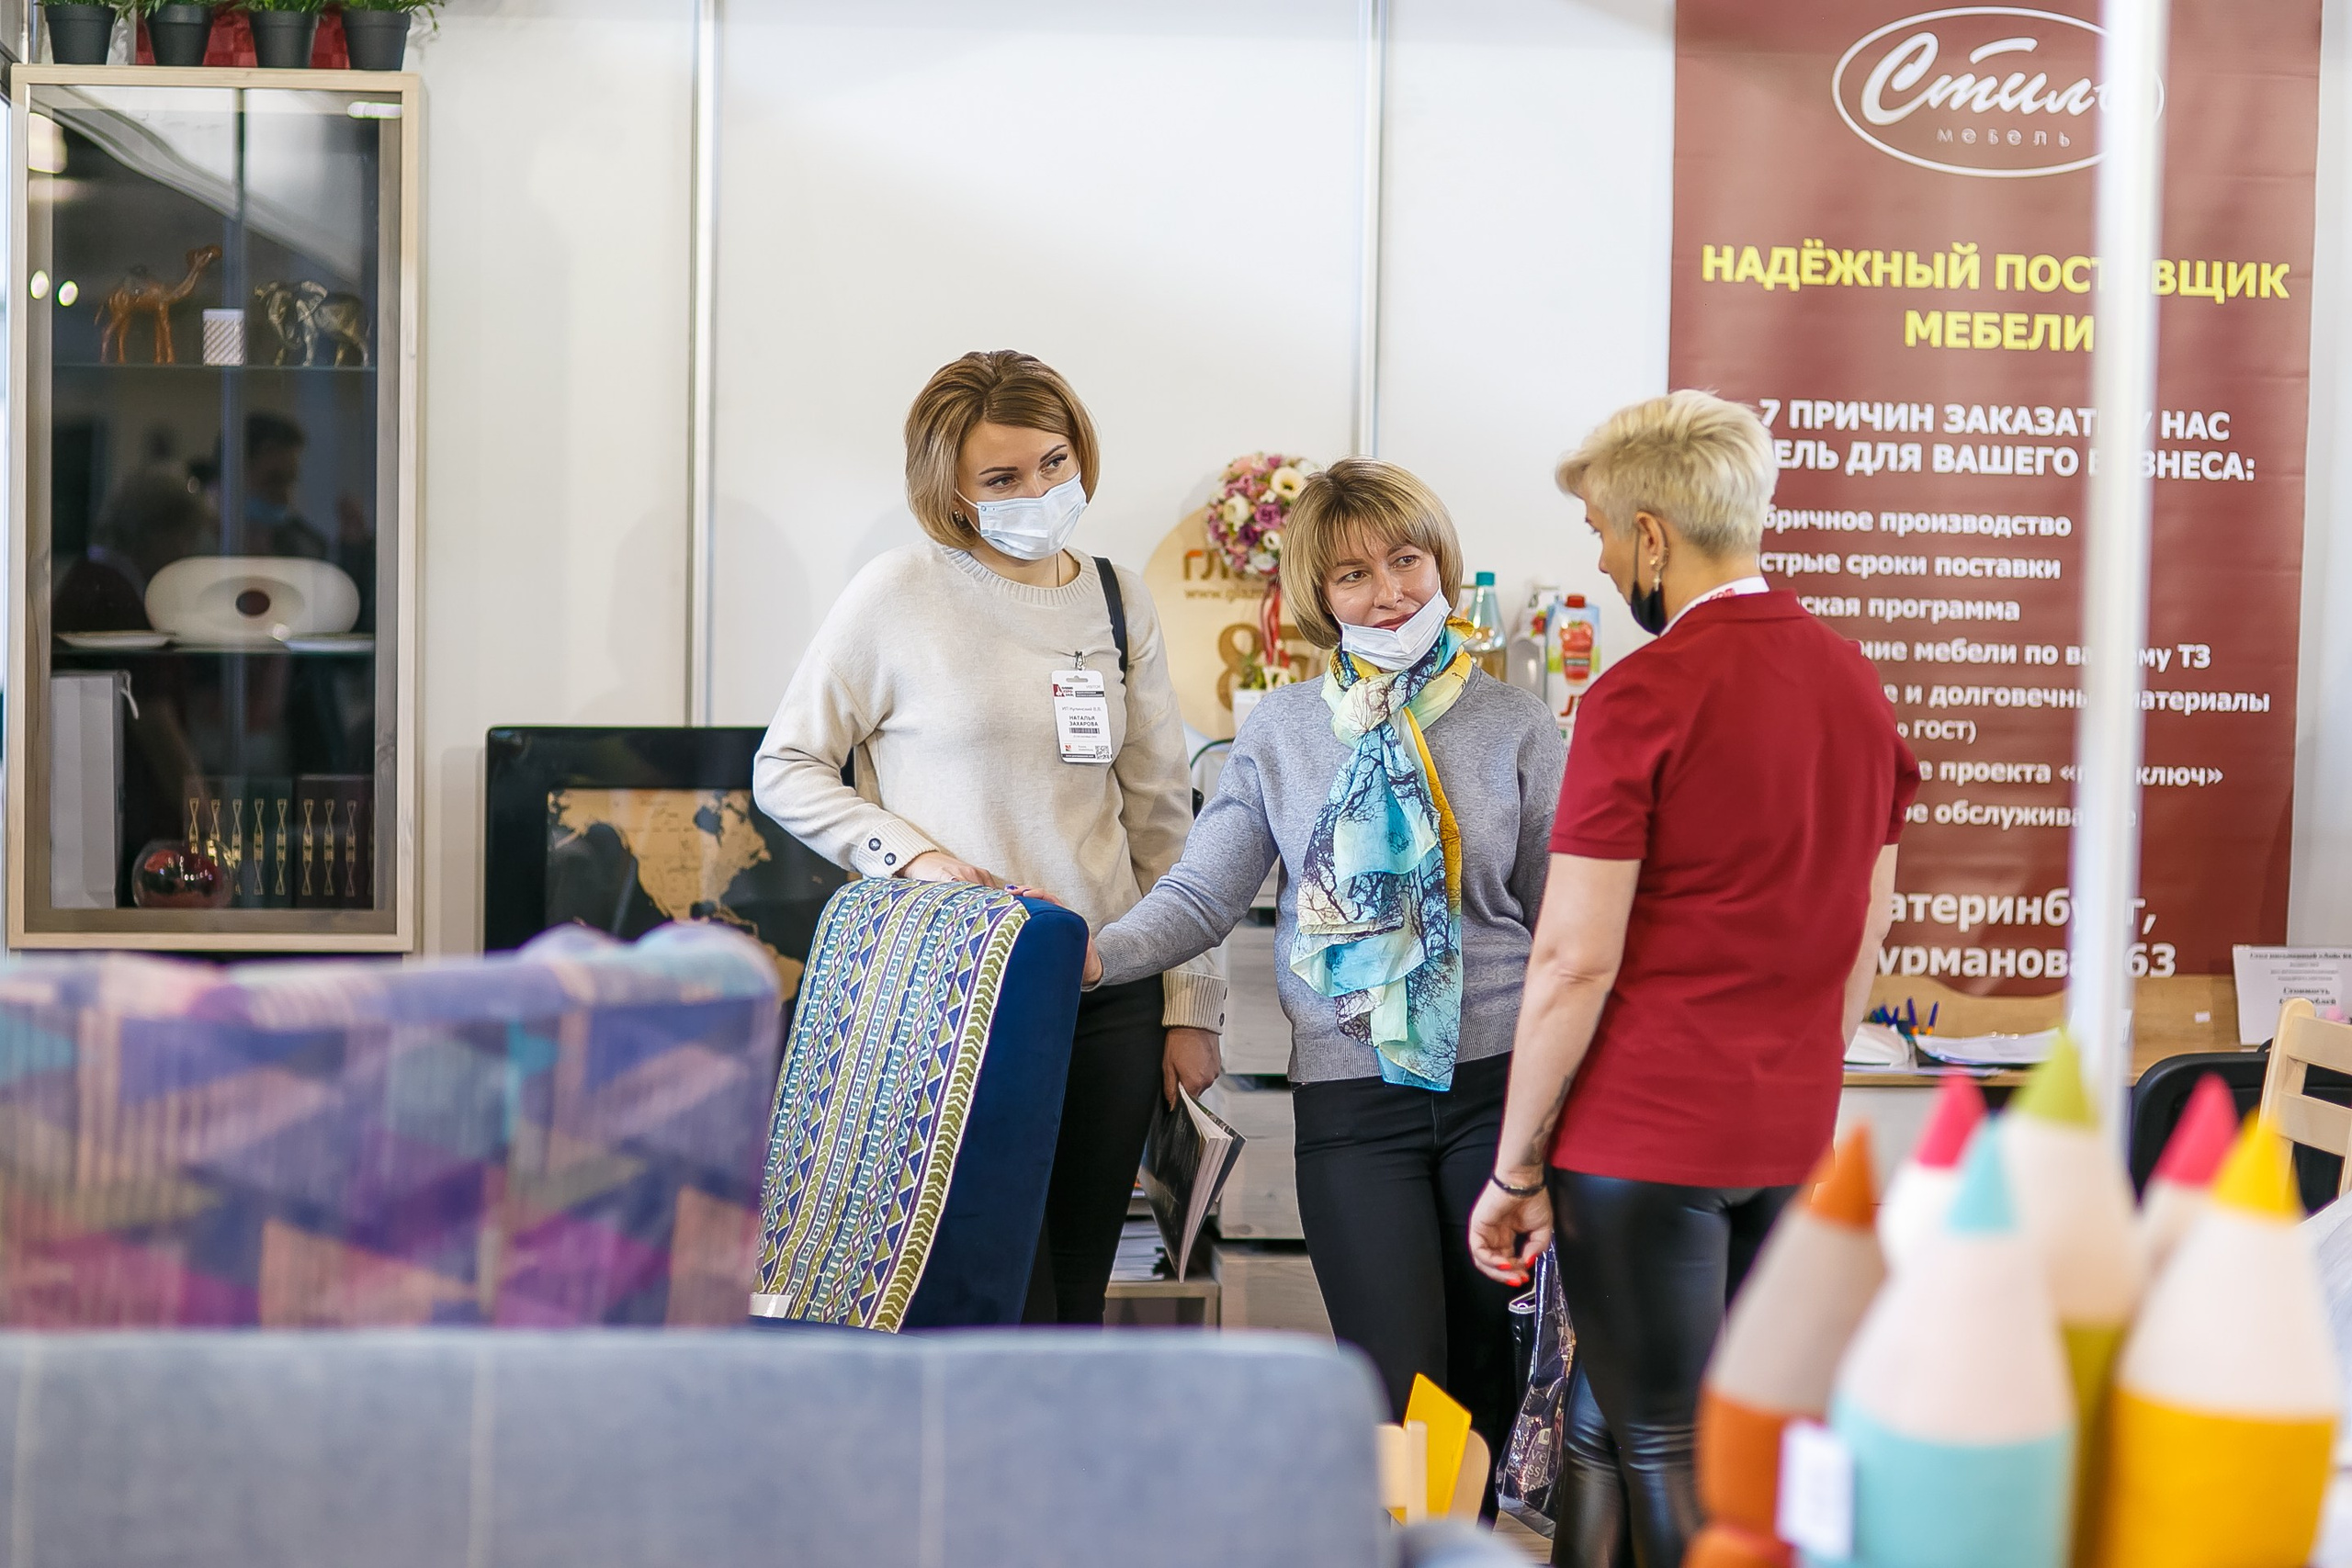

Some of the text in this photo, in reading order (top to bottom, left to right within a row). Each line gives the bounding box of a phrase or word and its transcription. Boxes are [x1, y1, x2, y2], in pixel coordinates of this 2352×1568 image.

[1702, 237, 2290, 305] НАДЁЖНЫЙ ПОСТВЩИК
[1905, 309, 2095, 353] МЕБЕЛИ
[1758, 398, 1781, 429] 7
[1789, 399, 1935, 433] ПРИЧИН
[1942, 402, 2100, 438] ЗАКАЗАТ
[2161, 410, 2231, 442] НАС
[1773, 437, 1839, 470] ЕЛЬ
[1845, 440, 1922, 477] ДЛЯ
[1932, 442, 2080, 478] ВАШЕГО
[1763, 504, 2073, 539] бричное производство
[1757, 551, 2062, 580] стрые сроки поставки
[1797, 595, 2020, 625] ская программа
[1860, 639, 1908, 661] ние
[1914, 637, 2017, 665] мебели
[2024, 644, 2059, 666] по
[1905, 684, 1922, 705] и
[1928, 684, 2092, 709] долговечны
[1939, 760, 2052, 787] проекта
[2135, 764, 2224, 787] ключ»
[2124, 942, 2177, 979] 63
